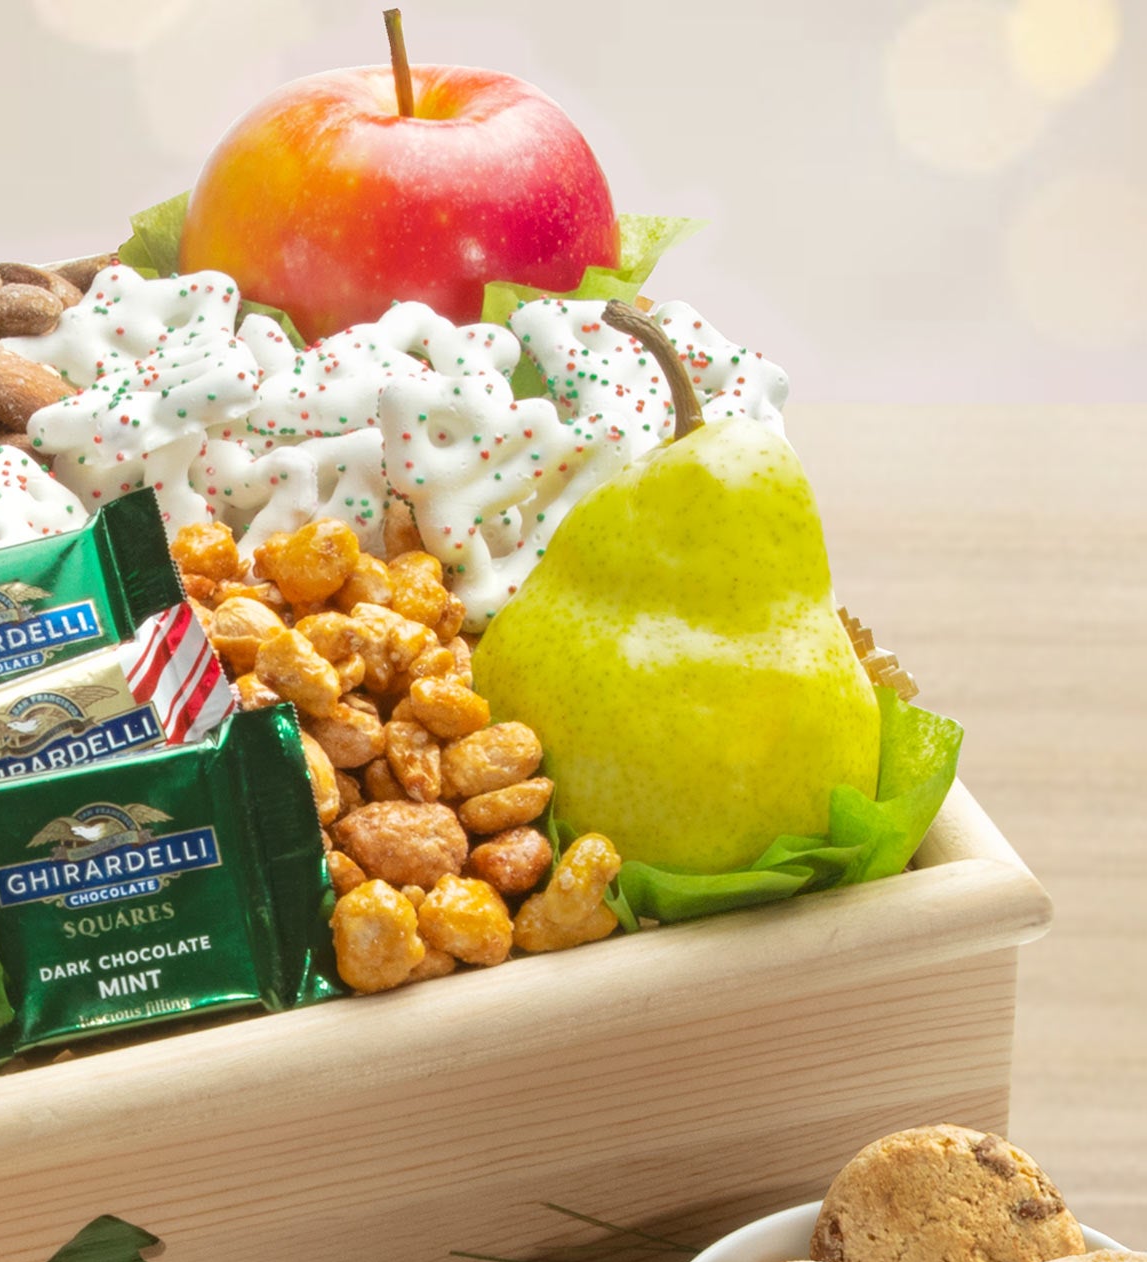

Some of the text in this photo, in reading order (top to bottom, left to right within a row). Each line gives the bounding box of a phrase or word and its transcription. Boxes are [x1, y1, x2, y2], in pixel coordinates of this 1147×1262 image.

[6, 837, 208, 895] GHIRARDELLI
[69, 879, 156, 907] CHOCOLATE
[63, 902, 175, 939] SQUARES
[39, 935, 212, 982] DARK CHOCOLATE
[97, 968, 162, 1000] MINT
